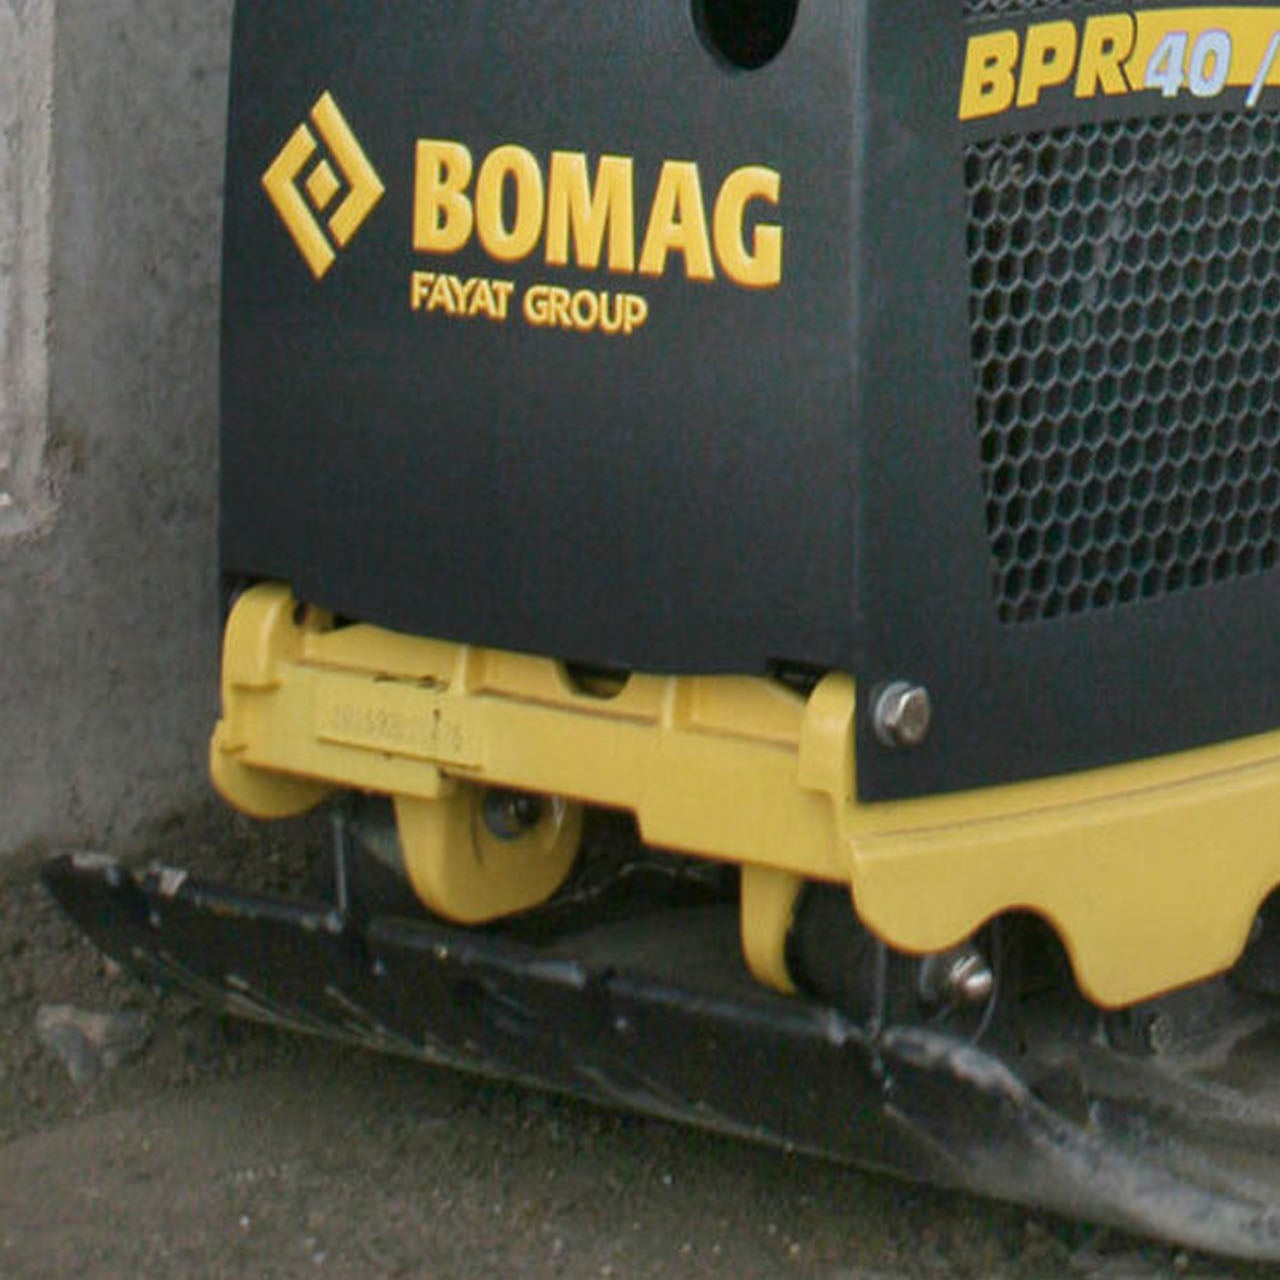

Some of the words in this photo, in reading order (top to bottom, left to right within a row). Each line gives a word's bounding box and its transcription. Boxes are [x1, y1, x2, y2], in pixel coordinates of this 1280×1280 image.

[957, 10, 1136, 121] BPR
[1144, 29, 1232, 97] 40
[412, 138, 784, 289] BOMAG
[410, 271, 514, 320] FAYAT
[522, 284, 649, 335] GROUP
